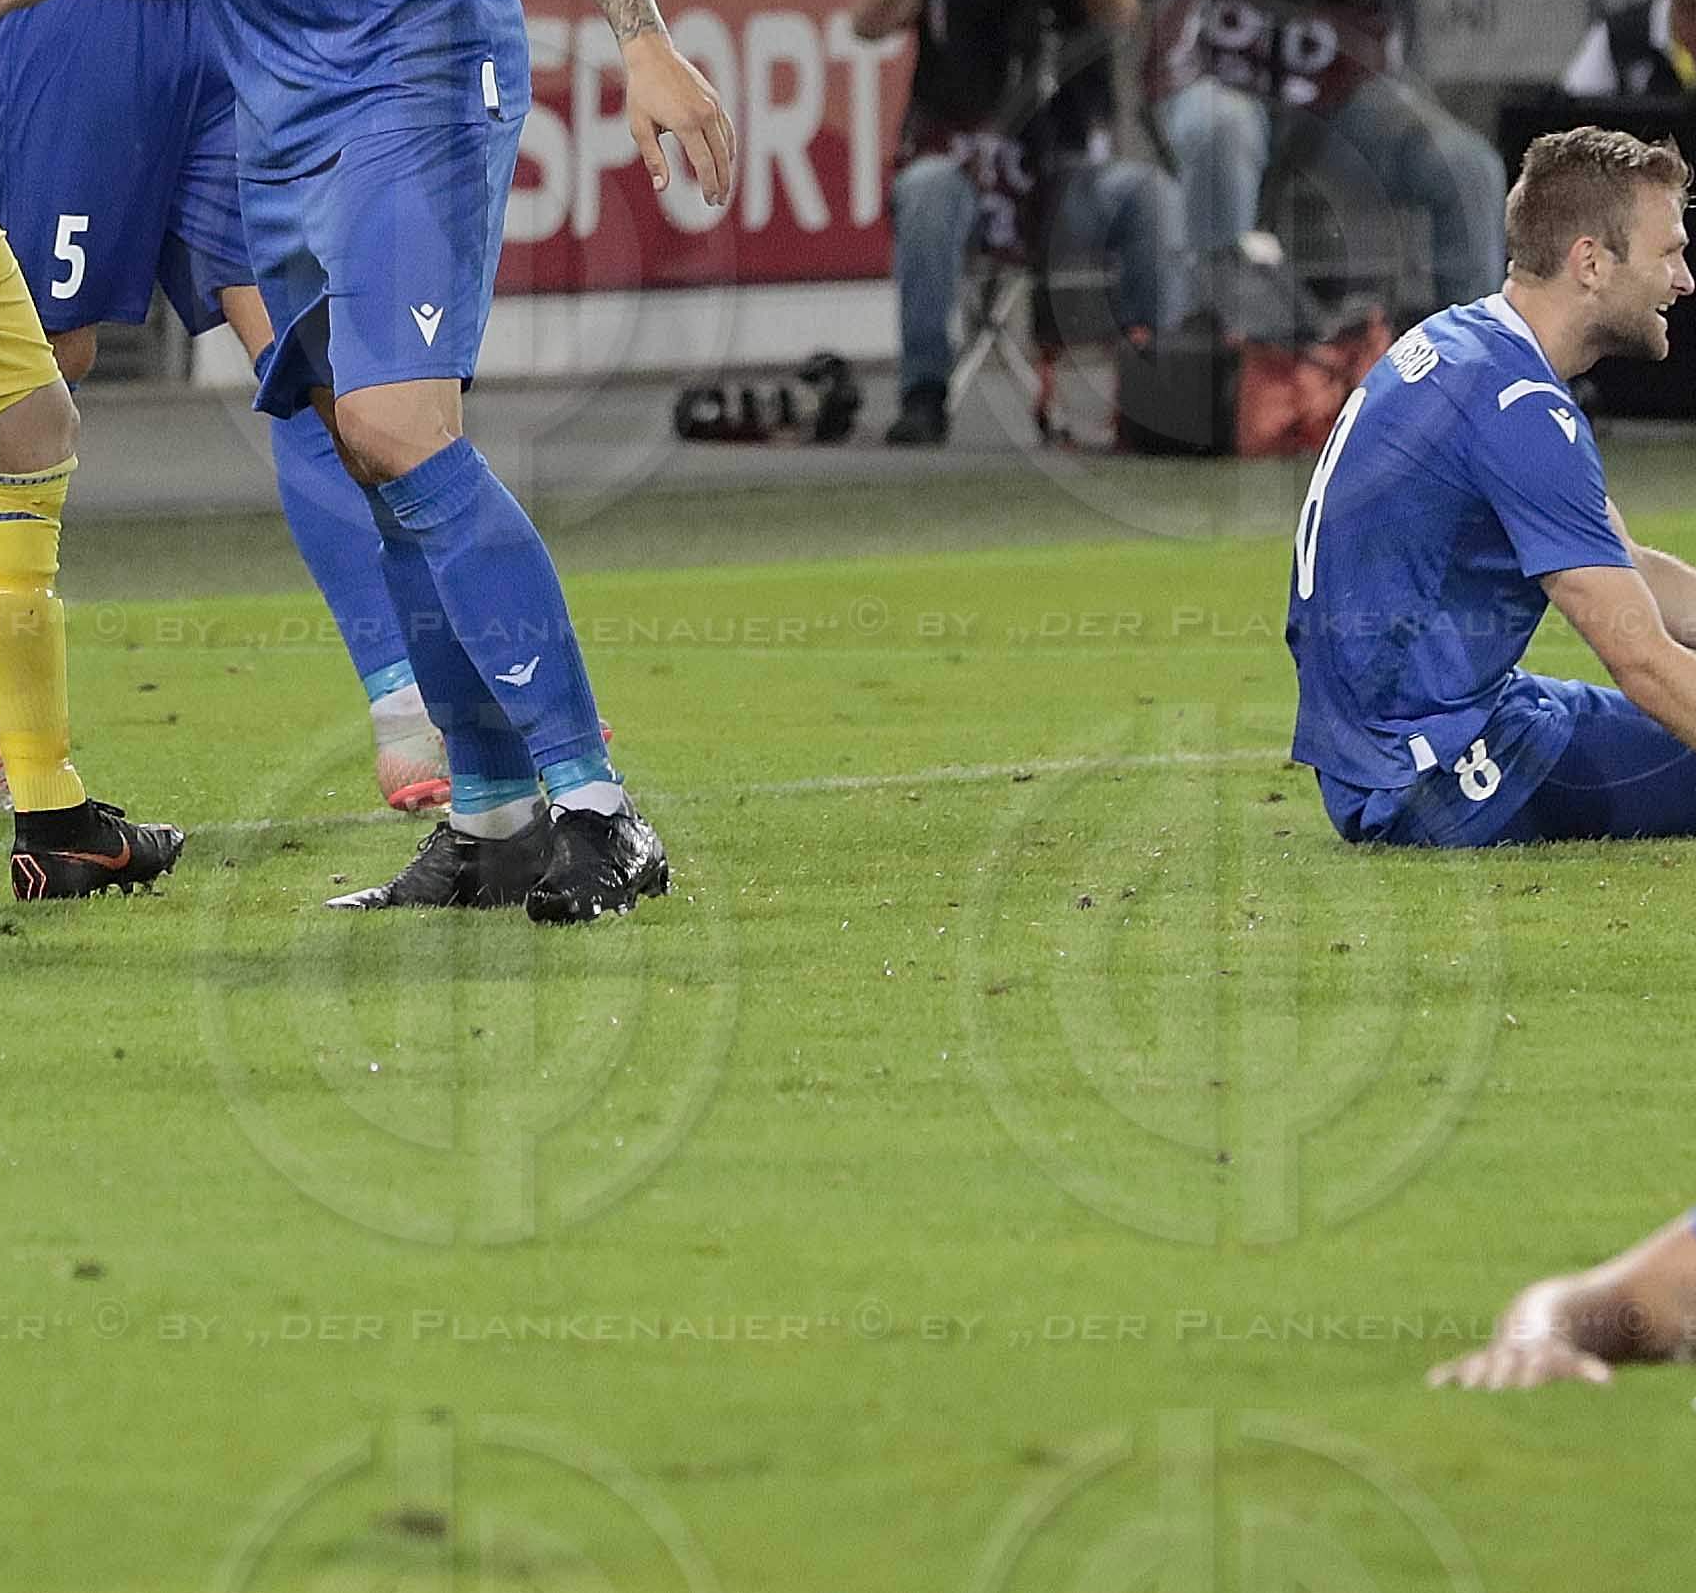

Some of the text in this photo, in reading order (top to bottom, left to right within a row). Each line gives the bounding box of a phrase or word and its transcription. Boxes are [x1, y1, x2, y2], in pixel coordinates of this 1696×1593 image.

[504, 10, 911, 244] SPORT
[51, 214, 90, 299] 5
[1454, 738, 1502, 801] 8
